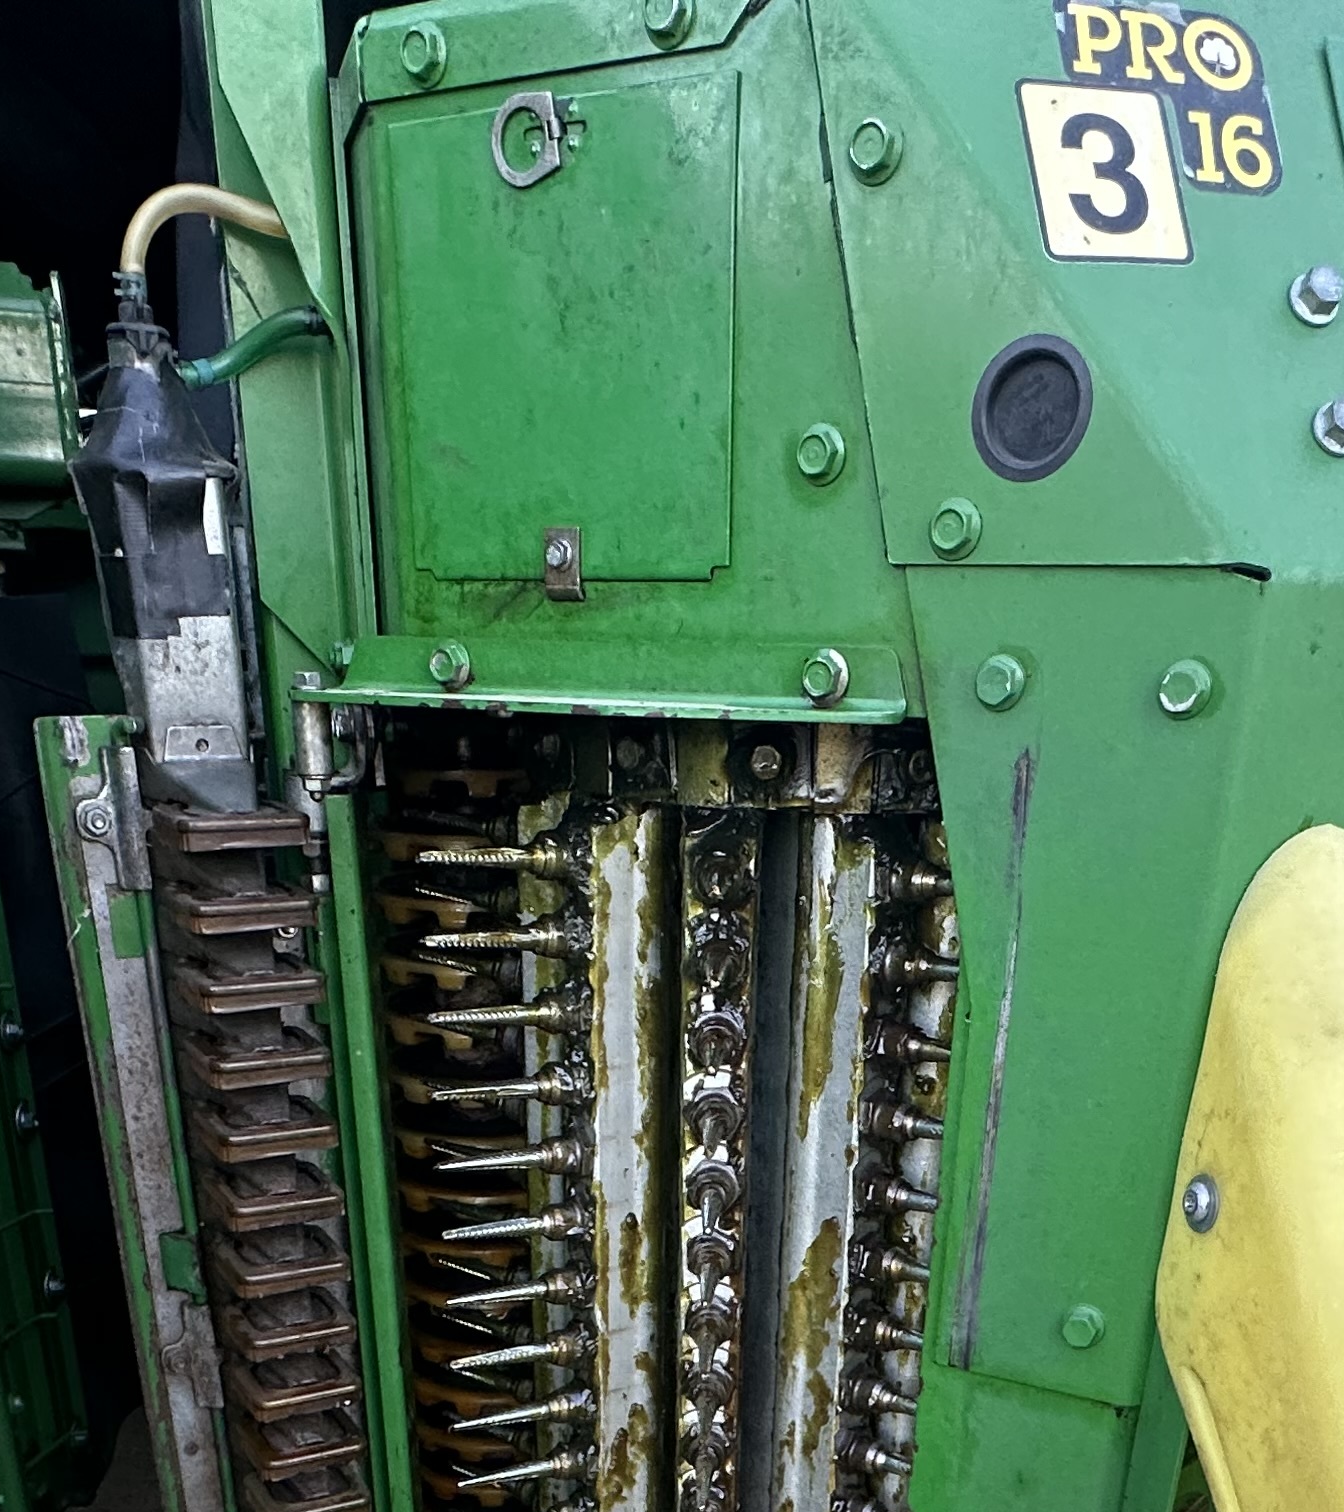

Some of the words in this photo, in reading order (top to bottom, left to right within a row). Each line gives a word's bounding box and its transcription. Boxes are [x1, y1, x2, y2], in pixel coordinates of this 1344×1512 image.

[1067, 3, 1253, 92] PRO
[1060, 113, 1149, 235] 3
[1188, 110, 1274, 189] 16
